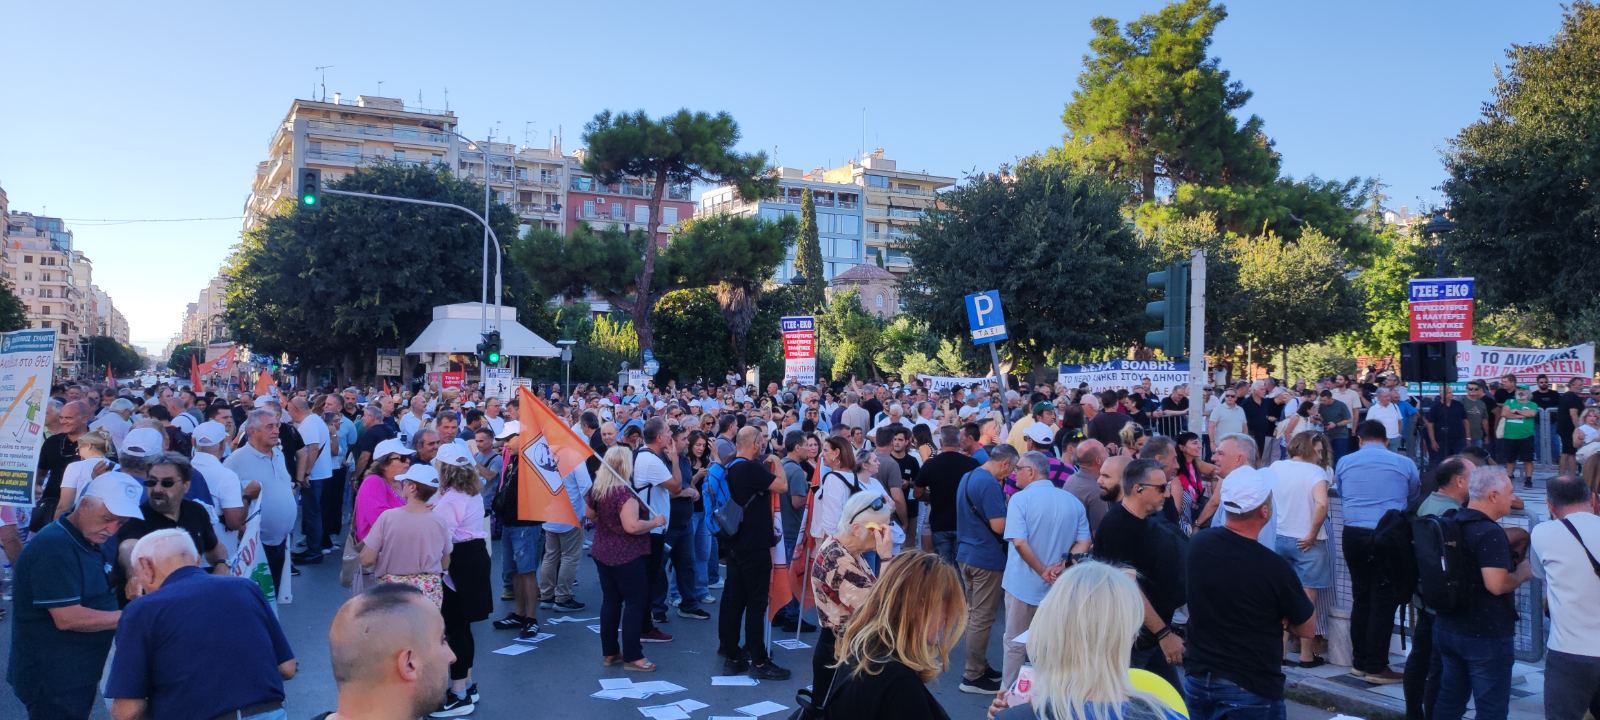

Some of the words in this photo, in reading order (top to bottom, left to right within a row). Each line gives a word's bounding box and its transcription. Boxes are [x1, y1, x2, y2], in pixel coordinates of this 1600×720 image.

[1412, 285, 1439, 298] ΓΣΕΕ
[1445, 284, 1469, 297] ΕΚΘ
[974, 294, 994, 327] P
[1413, 304, 1469, 312] ΠΕΡΙΣΣΟΤΕΡΕΣ
[1481, 351, 1499, 364] ΤΟ
[1504, 353, 1546, 366] ΔΙΚΙΟ
[1121, 360, 1176, 371] ΒΟΛΒΗΣ
[1474, 364, 1499, 377] ΔΕΝ
[1074, 374, 1091, 383] ΝΕΡΟ
[1153, 372, 1190, 382] ΔΗΜΟΤ
